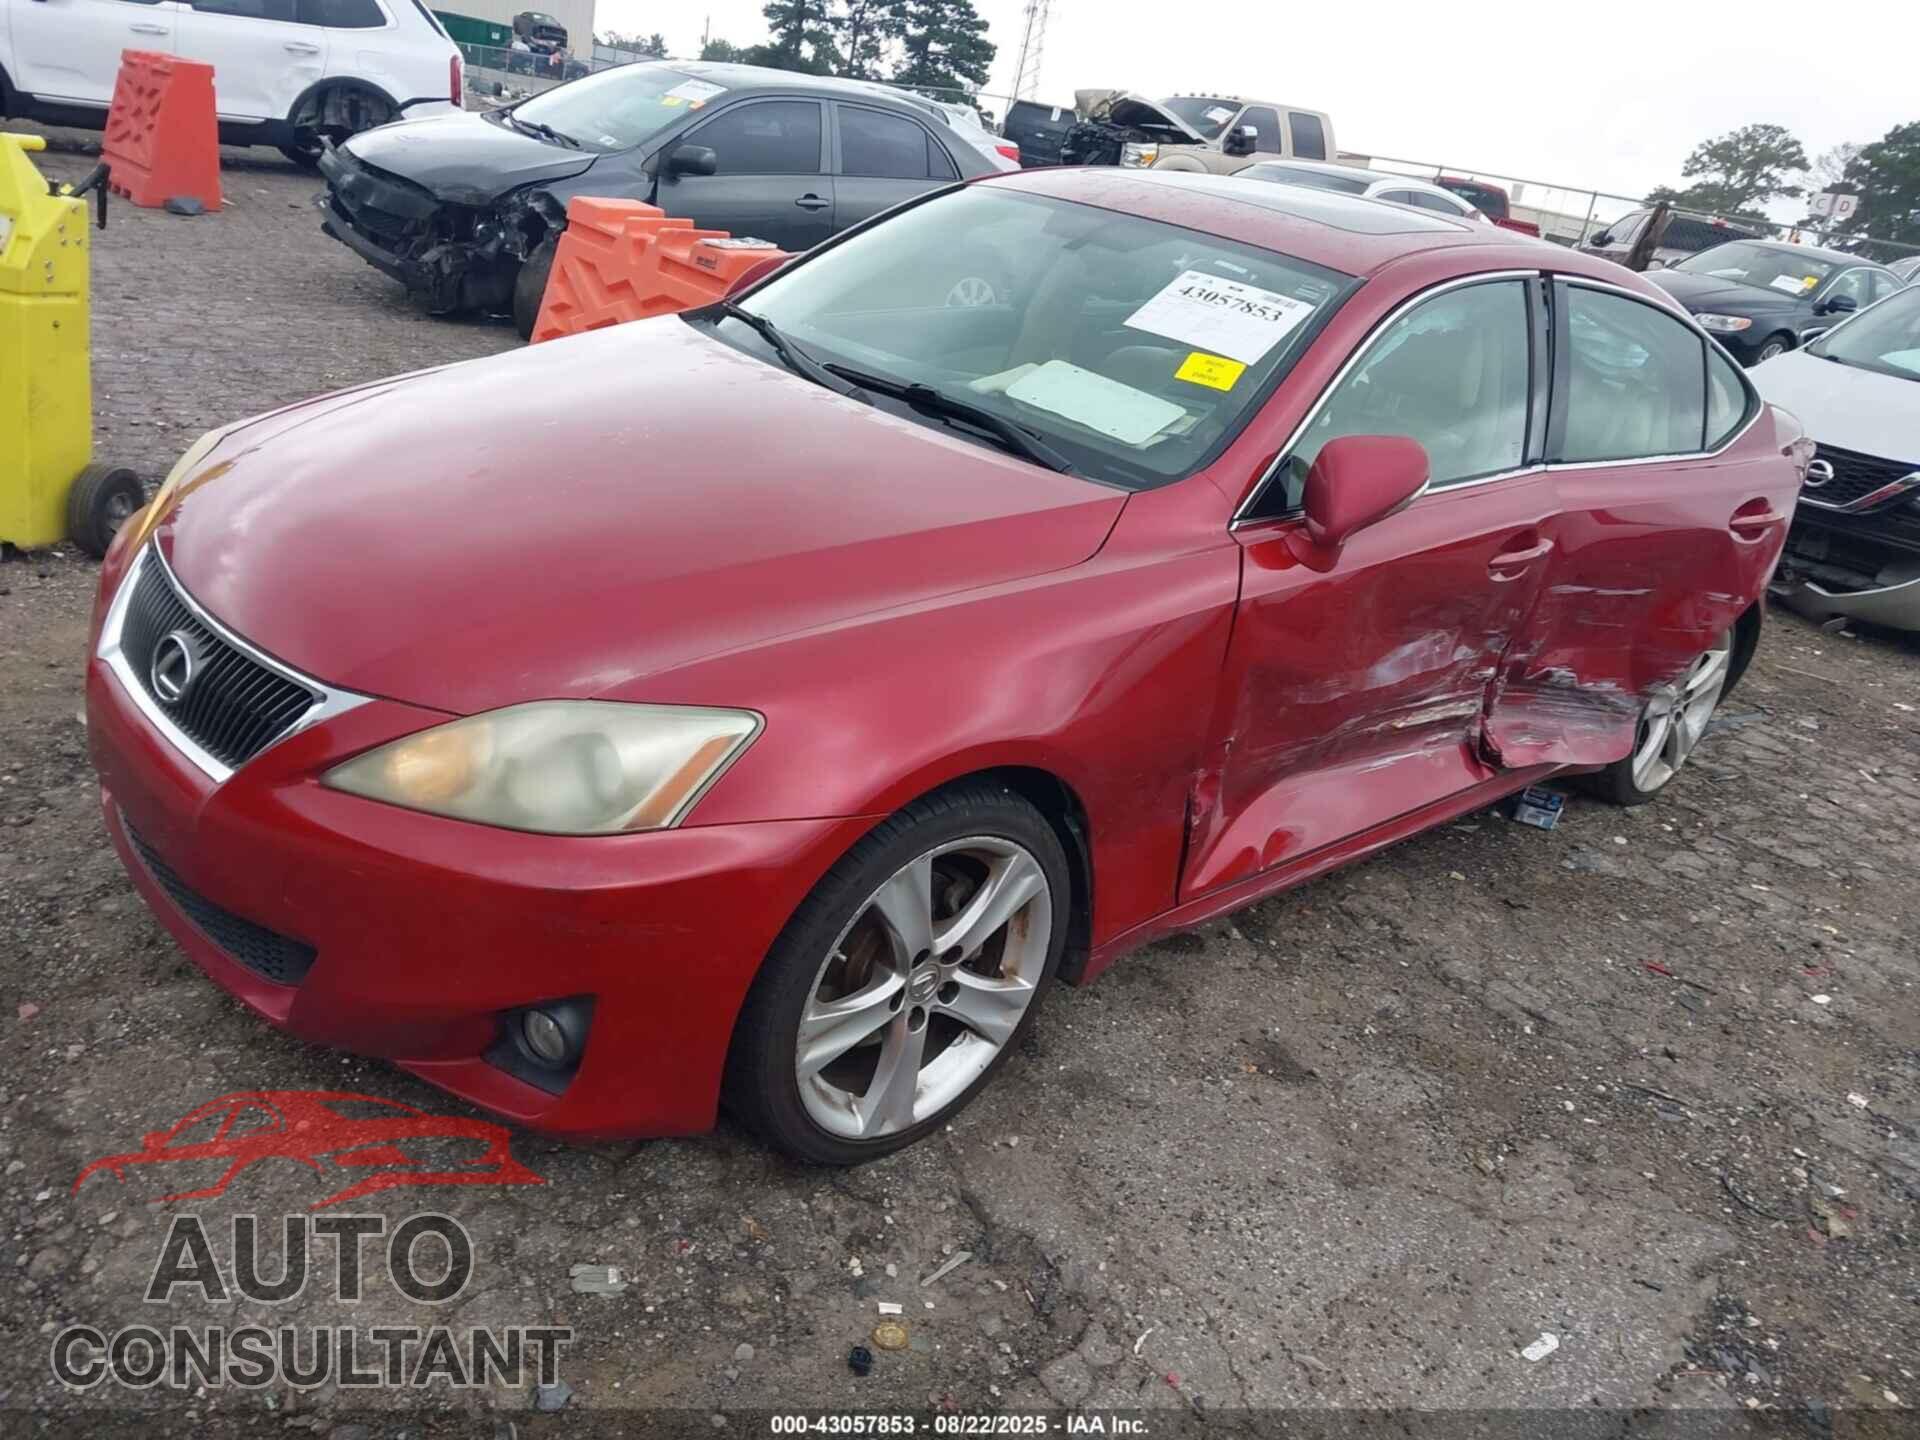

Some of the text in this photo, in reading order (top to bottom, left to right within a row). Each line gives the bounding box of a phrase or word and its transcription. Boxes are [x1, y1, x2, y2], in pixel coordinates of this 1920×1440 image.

[1815, 198, 1827, 210] C
[1839, 200, 1851, 213] D
[1179, 285, 1283, 322] 43057853
